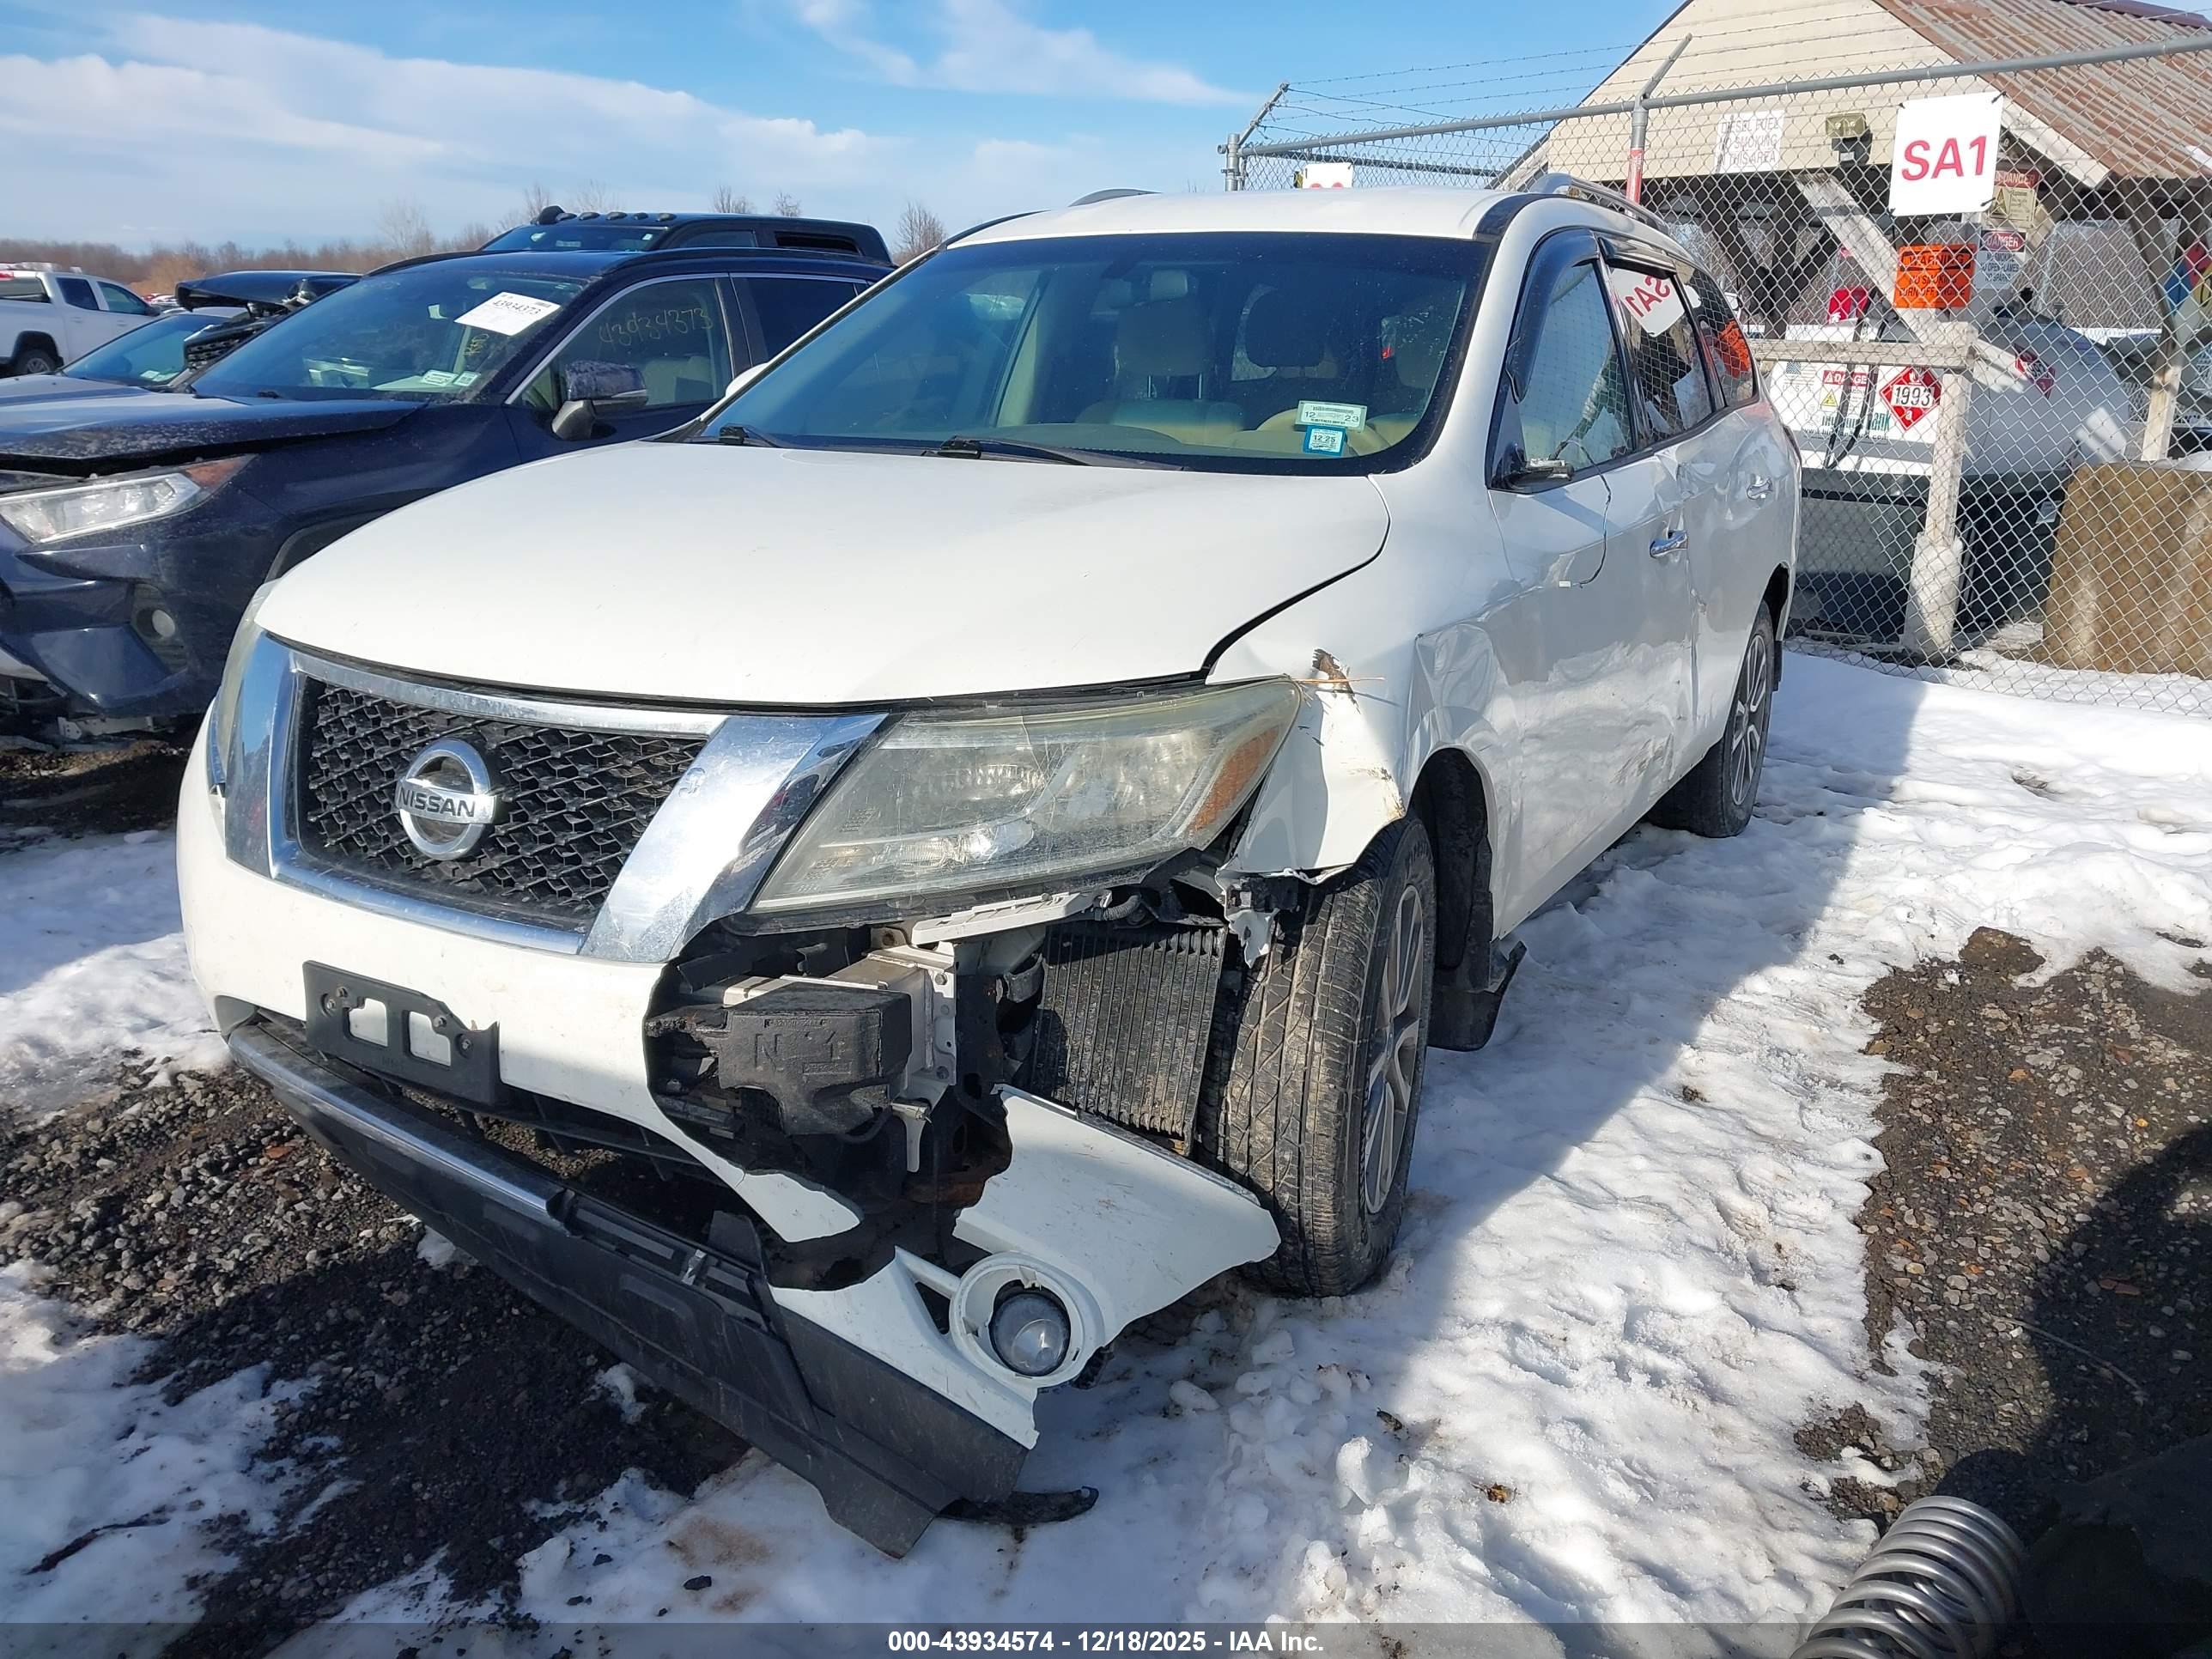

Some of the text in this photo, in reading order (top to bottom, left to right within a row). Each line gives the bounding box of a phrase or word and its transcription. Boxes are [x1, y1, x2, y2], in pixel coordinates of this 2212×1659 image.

[1901, 134, 1987, 181] SA1
[1987, 235, 2019, 248] DANGER
[1909, 253, 1965, 266] WARNING
[1895, 386, 1931, 407] 1993
[398, 786, 476, 817] NISSAN
